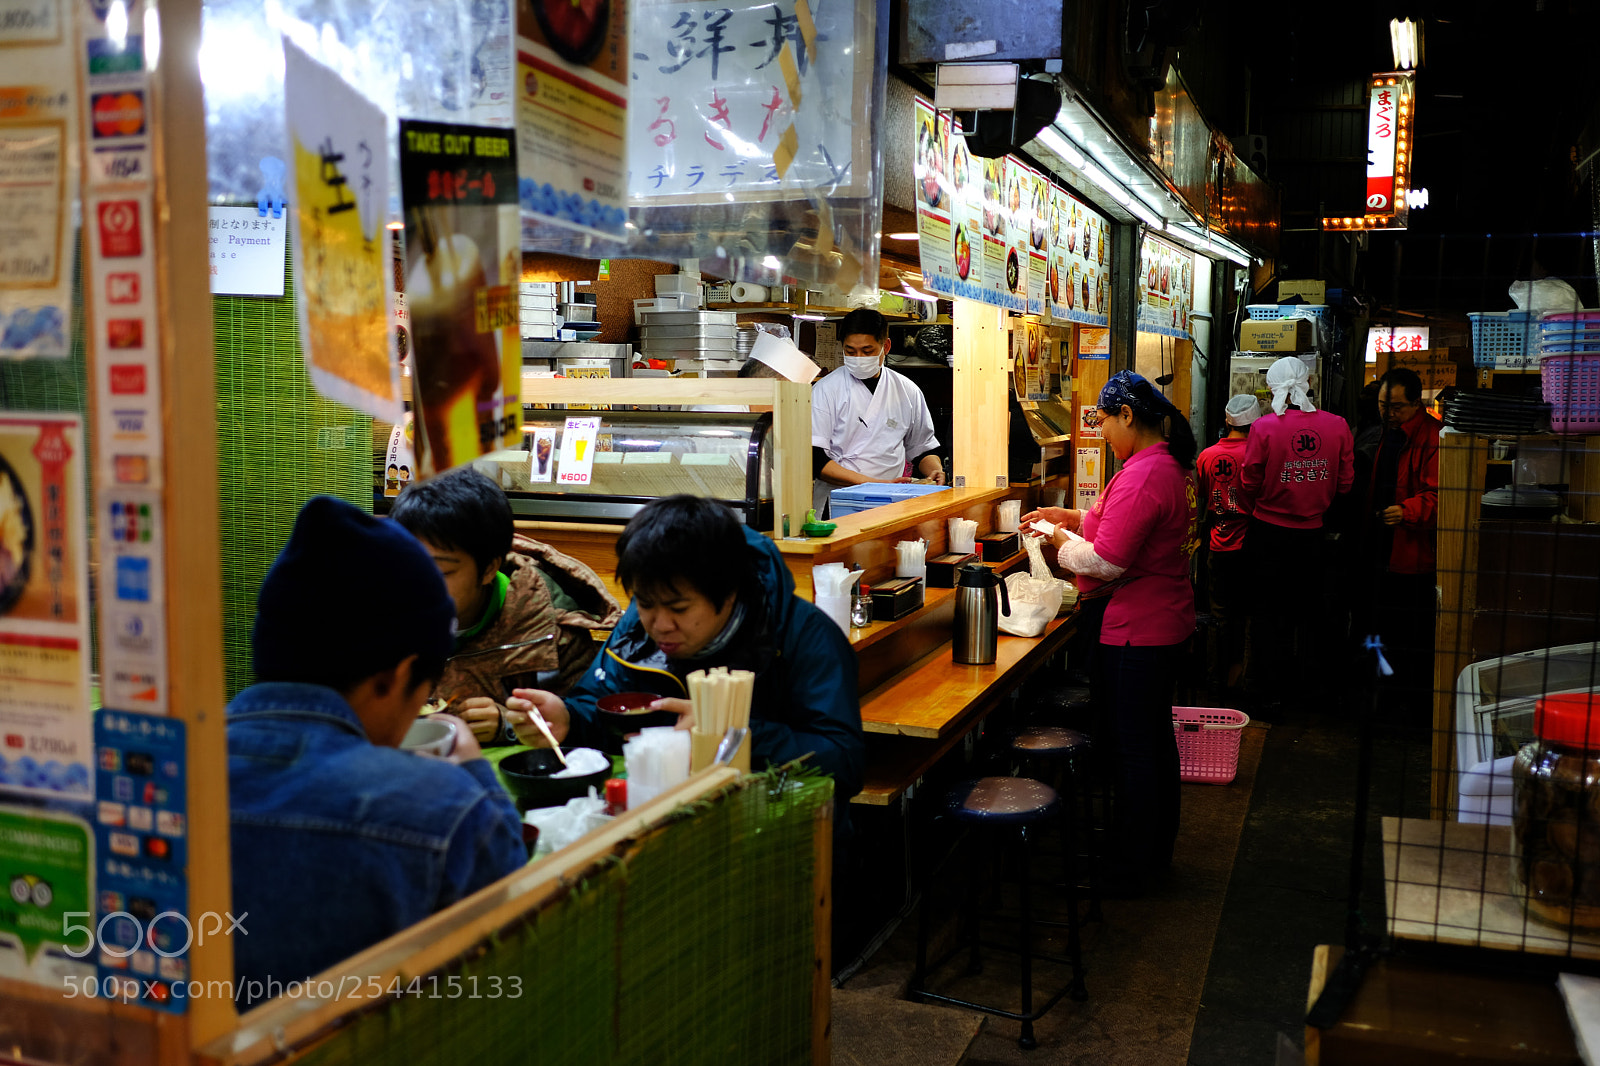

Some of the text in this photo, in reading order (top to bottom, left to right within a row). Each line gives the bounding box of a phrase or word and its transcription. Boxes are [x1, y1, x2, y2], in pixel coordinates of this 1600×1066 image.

[1375, 90, 1393, 138] まぐろ
[406, 131, 510, 157] TAKE OUT BEER
[628, 159, 780, 188] チラデス
[1366, 194, 1387, 208] の
[228, 235, 271, 246] Payment
[567, 421, 595, 429] 生ビール
[1297, 434, 1316, 452] 北
[1215, 459, 1232, 477] 北
[1280, 468, 1328, 483] まるきた
[561, 473, 588, 482] ¥600
